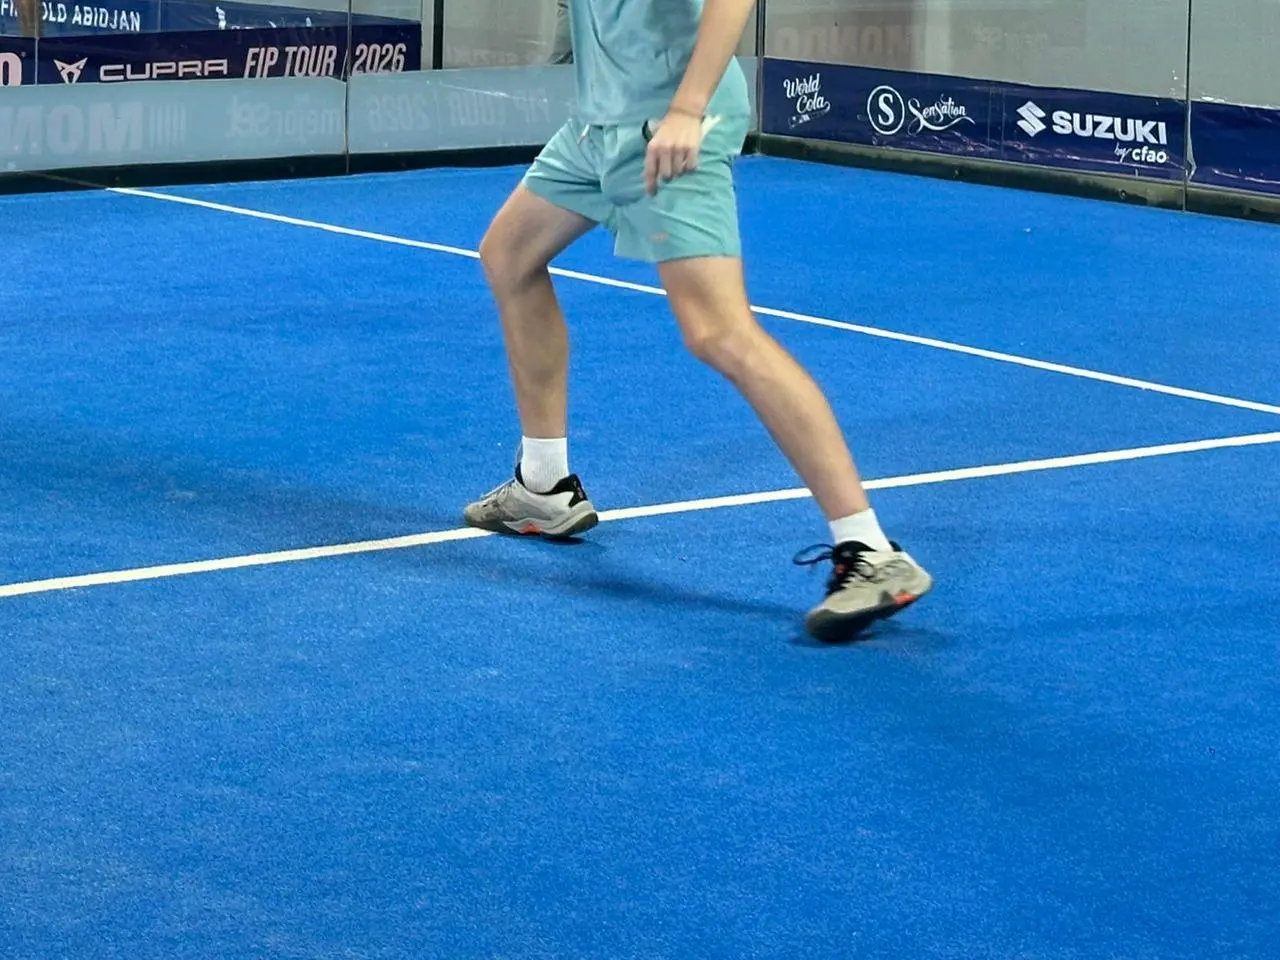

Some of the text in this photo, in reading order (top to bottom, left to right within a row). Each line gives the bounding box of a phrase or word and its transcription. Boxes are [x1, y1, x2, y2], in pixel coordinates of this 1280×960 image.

[71, 5, 141, 32] ABIDJAN
[99, 59, 228, 82] CUPRA
[244, 46, 279, 80] FIP
[284, 44, 338, 78] TOUR
[351, 42, 408, 77] 2026
[783, 72, 821, 98] World
[796, 90, 831, 115] Cola
[907, 93, 976, 136] Sensation
[1051, 110, 1168, 145] SUZUKI
[1131, 145, 1167, 164] cfao
